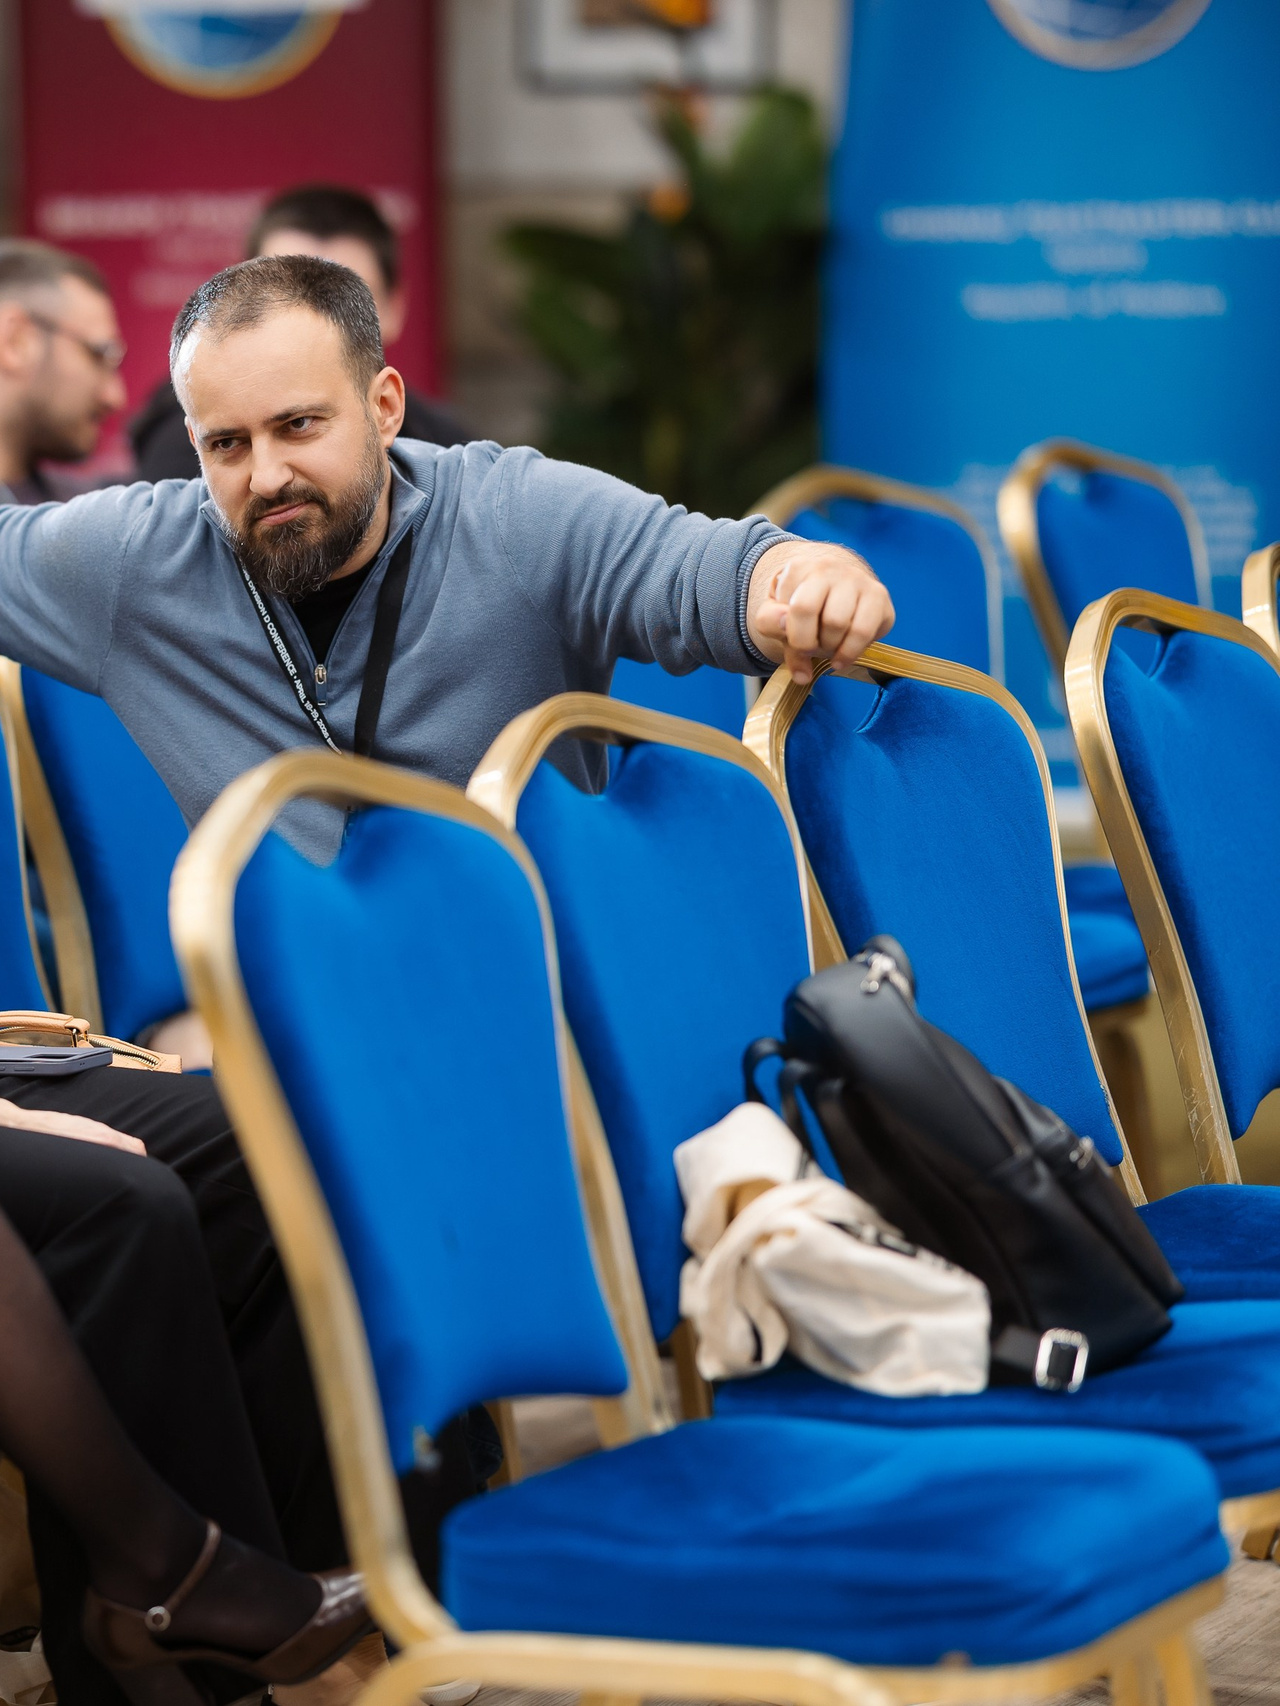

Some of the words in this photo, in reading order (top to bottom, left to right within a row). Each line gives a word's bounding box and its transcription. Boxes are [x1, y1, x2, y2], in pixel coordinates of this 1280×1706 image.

[248, 580, 267, 616] DIVISION
[263, 614, 270, 623] D
[267, 622, 297, 676] CONFERENCE
[294, 679, 307, 703] APRIL
